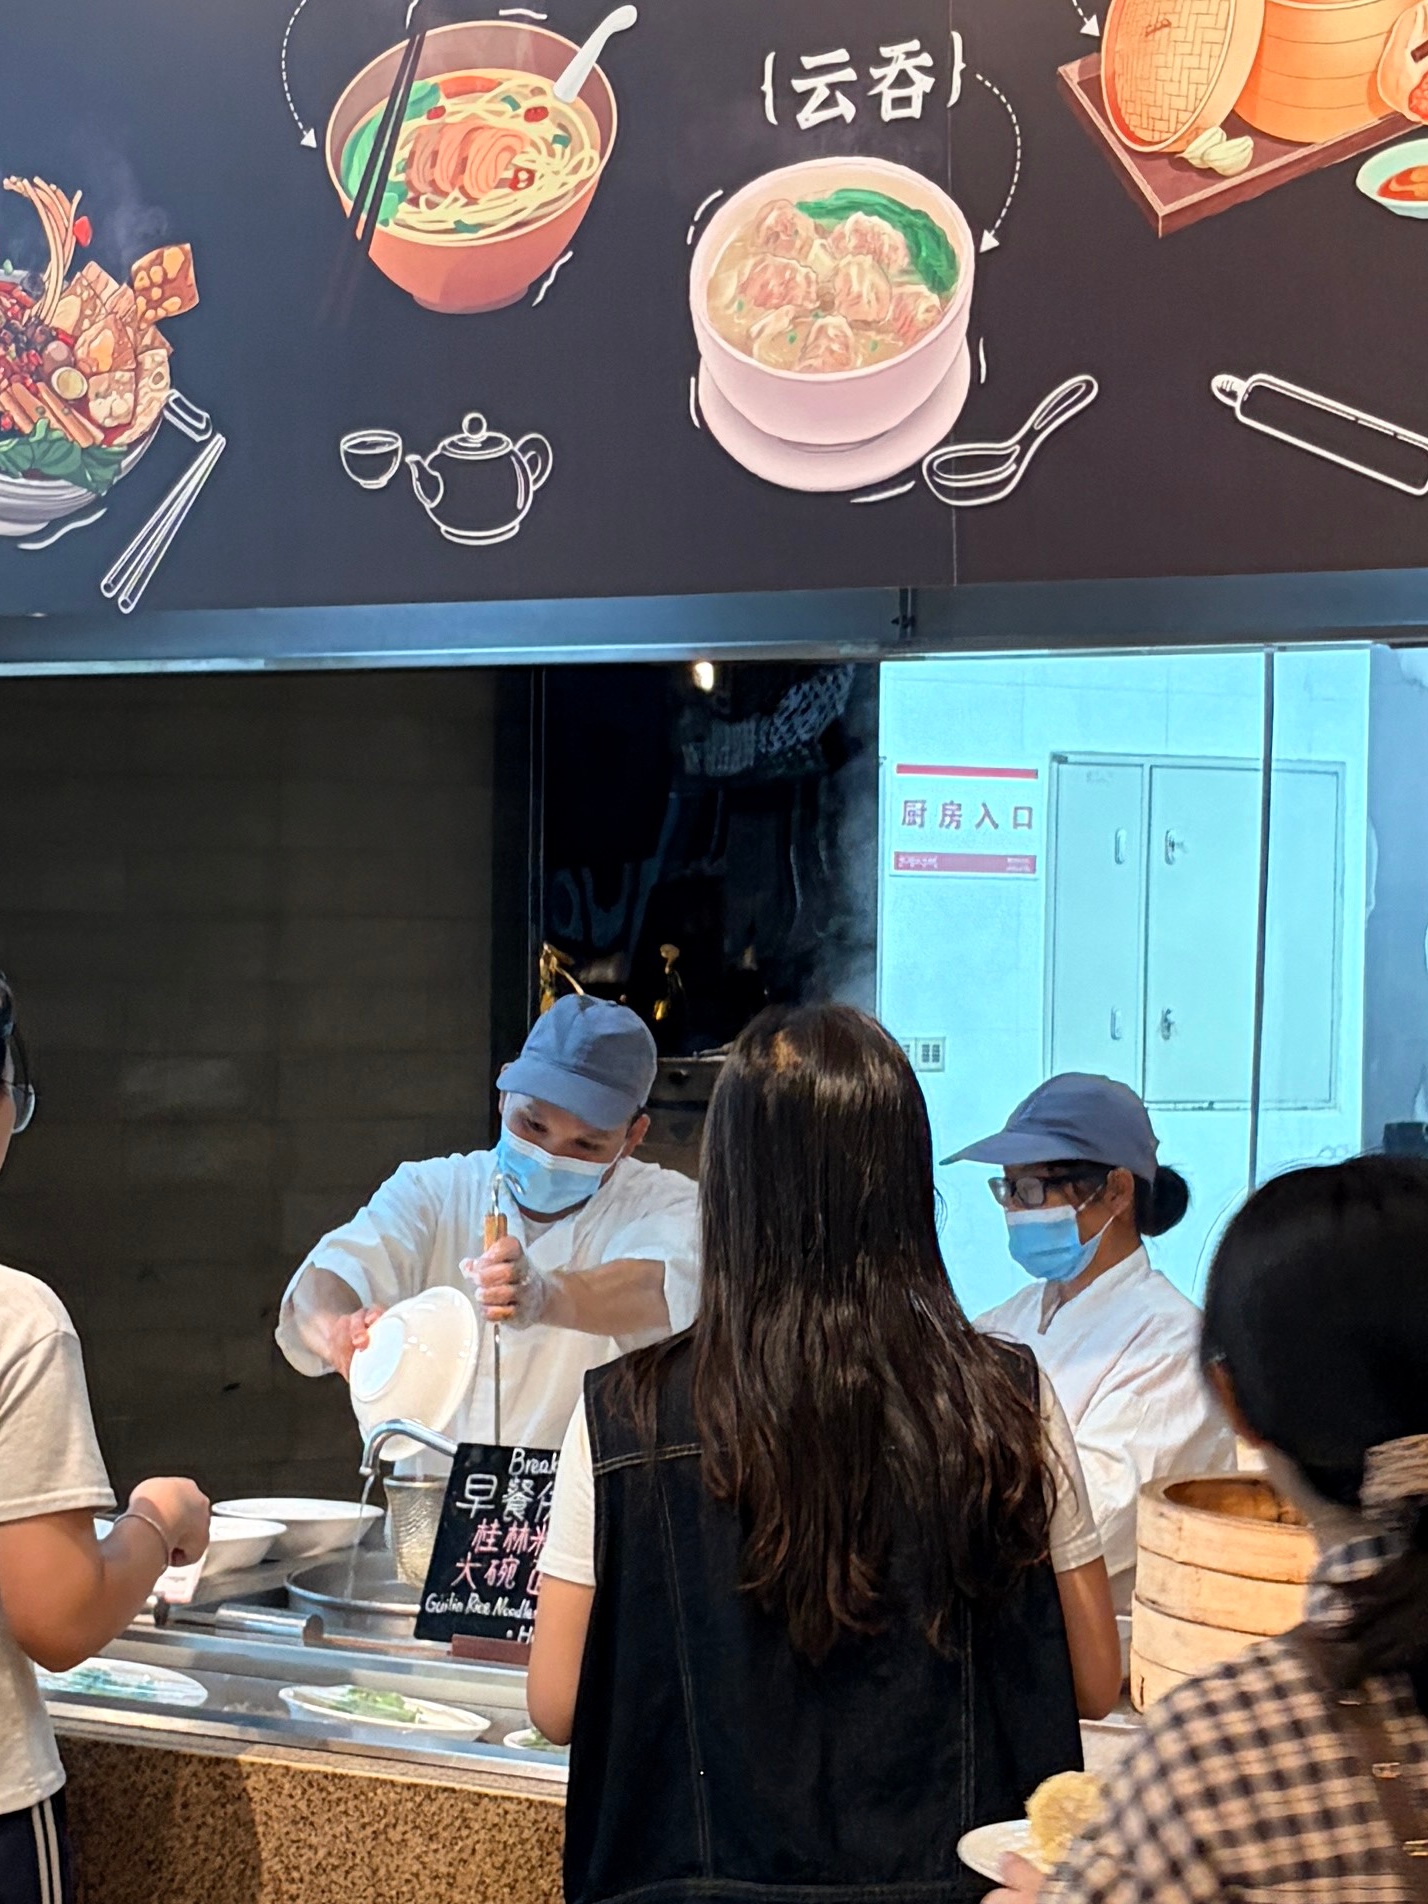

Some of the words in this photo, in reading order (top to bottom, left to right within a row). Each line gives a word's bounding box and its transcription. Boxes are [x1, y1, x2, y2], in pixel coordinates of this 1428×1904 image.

[901, 799, 1034, 831] 厨房入口
[492, 1595, 537, 1620] Noodle
